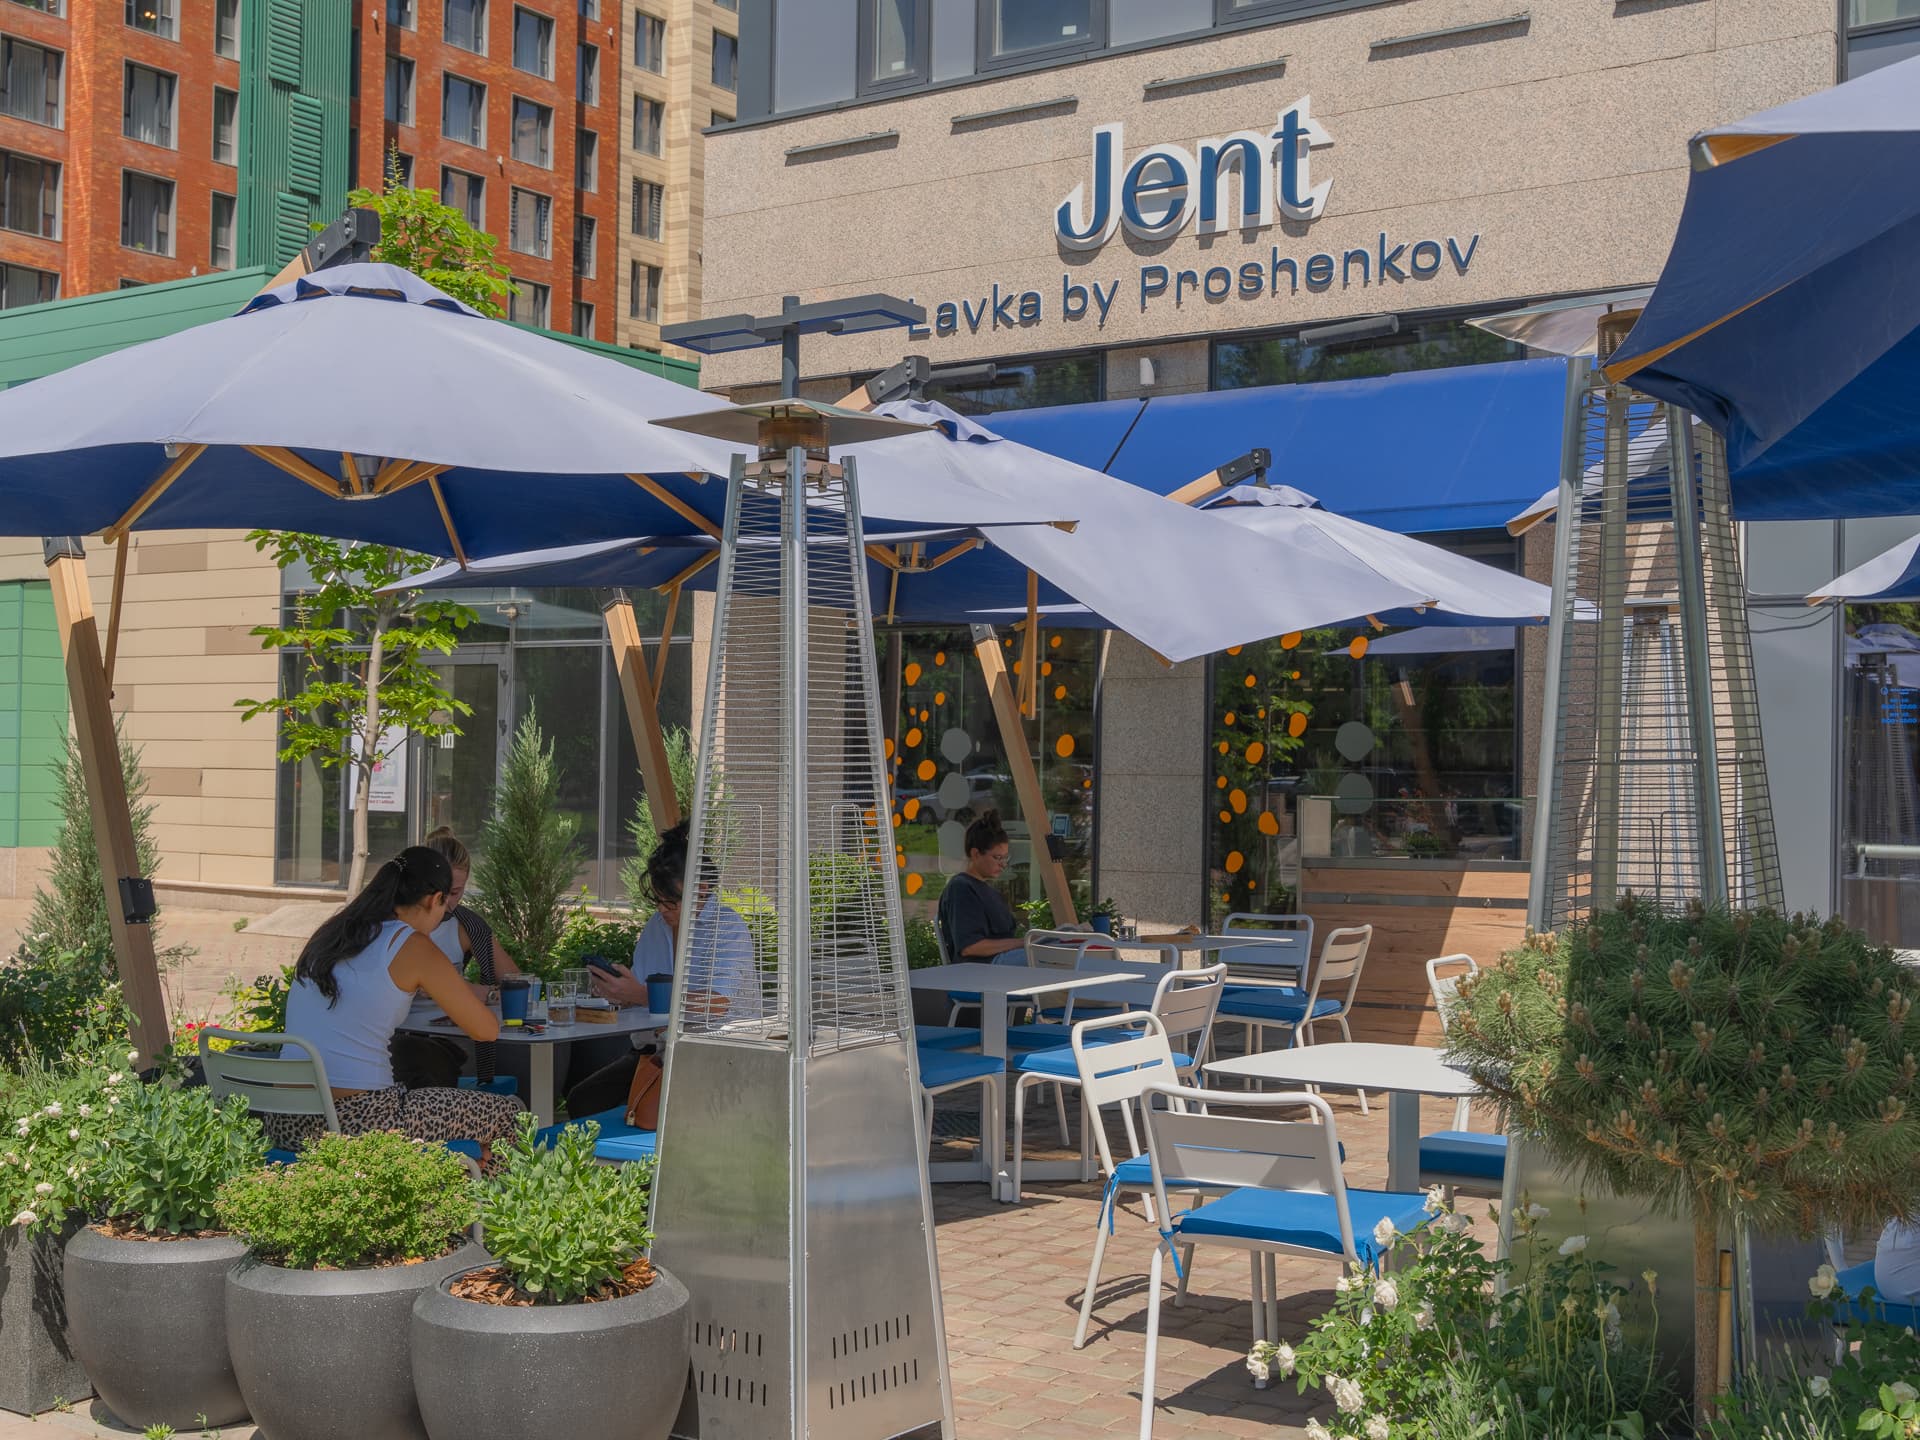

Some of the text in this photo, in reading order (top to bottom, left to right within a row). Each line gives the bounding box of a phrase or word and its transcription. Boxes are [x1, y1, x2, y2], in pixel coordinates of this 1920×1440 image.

[1055, 96, 1332, 249] Jent
[1063, 274, 1119, 325] by
[1140, 232, 1481, 307] Proshenkov
